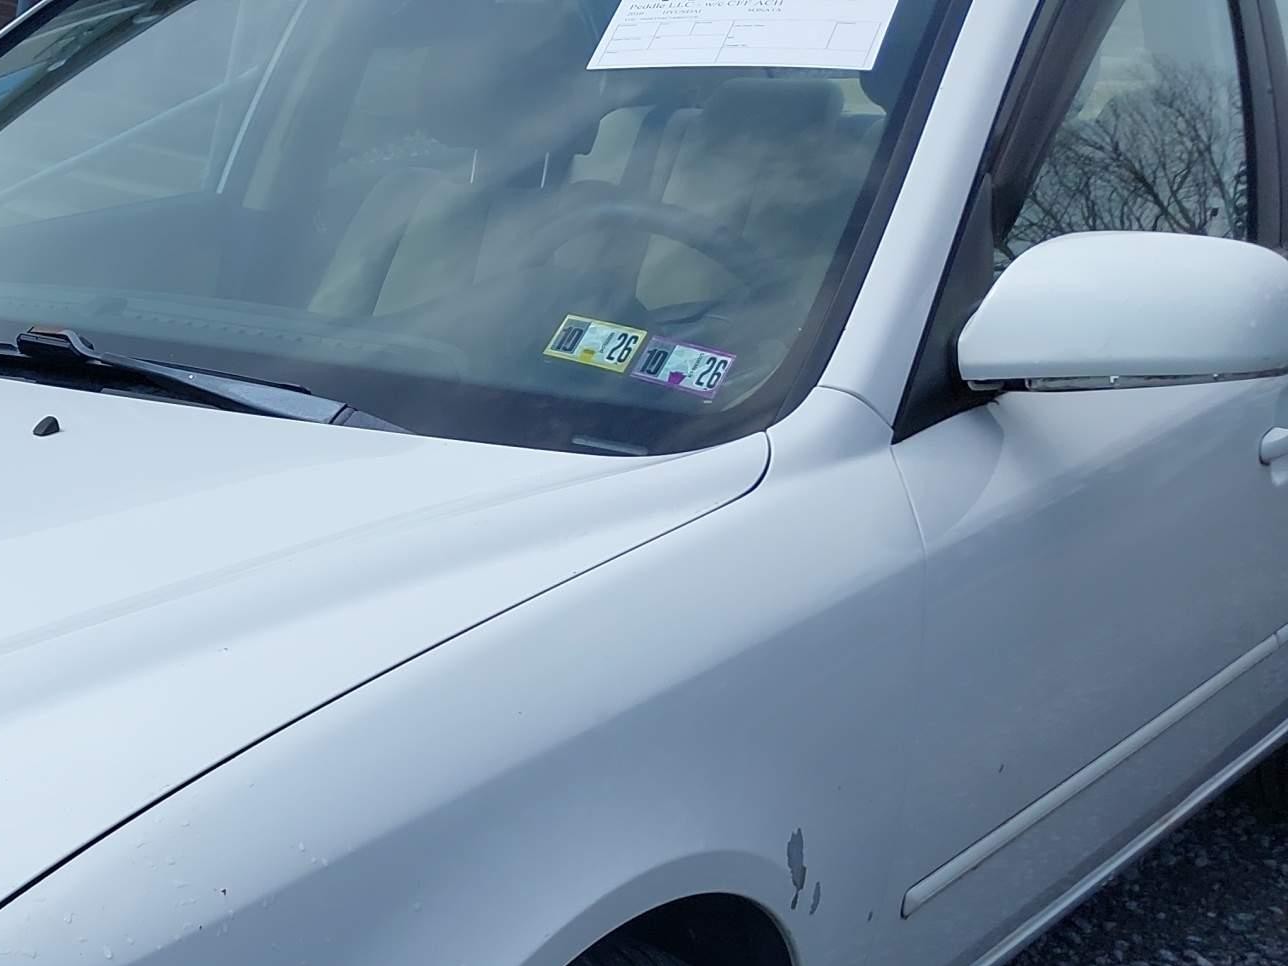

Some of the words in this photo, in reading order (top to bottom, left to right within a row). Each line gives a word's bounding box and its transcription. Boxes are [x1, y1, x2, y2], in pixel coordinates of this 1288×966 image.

[555, 326, 584, 353] 10
[606, 332, 640, 363] 26
[640, 348, 669, 375] 10
[695, 357, 729, 389] 26
